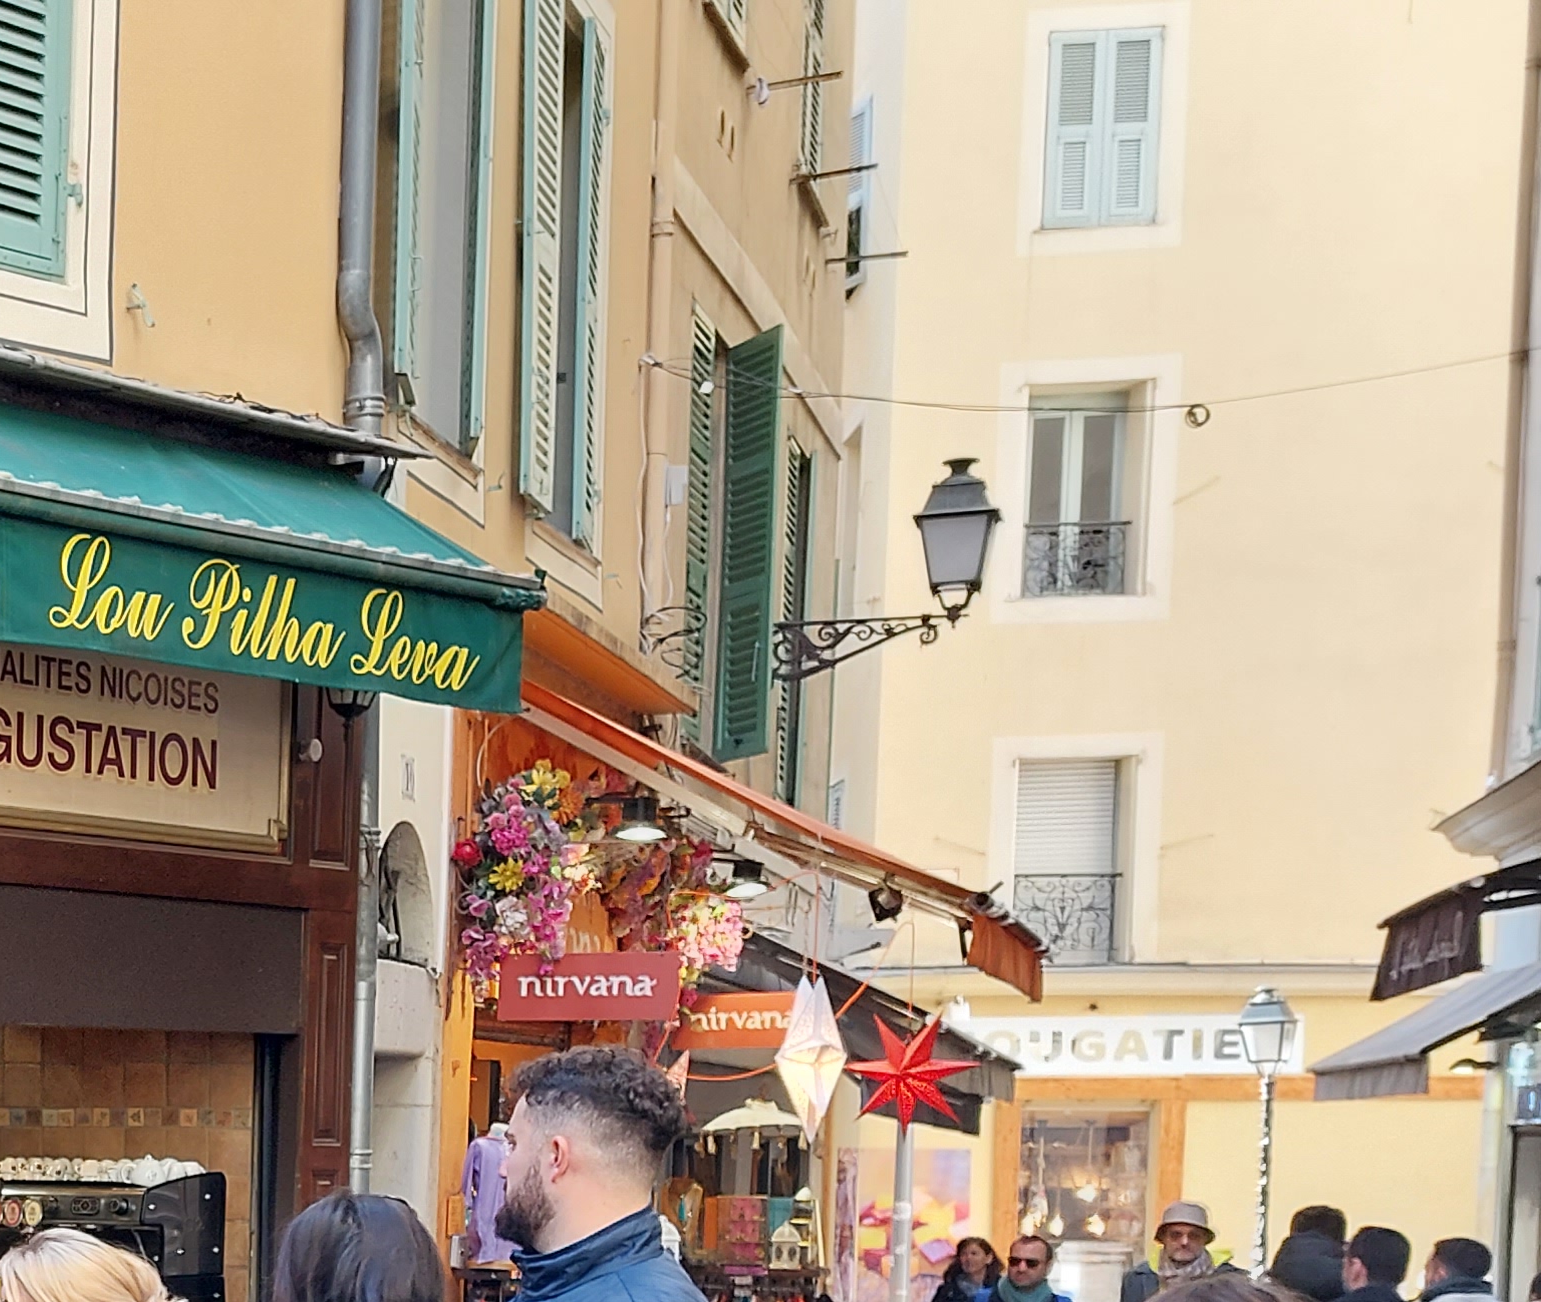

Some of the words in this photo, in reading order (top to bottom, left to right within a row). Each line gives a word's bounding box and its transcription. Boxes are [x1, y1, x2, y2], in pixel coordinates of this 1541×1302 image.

[49, 532, 175, 643] Lou
[181, 559, 345, 667] Pilha
[350, 588, 480, 692] Leva
[517, 974, 658, 998] nirvana
[983, 1028, 1242, 1063] OUGATIE
